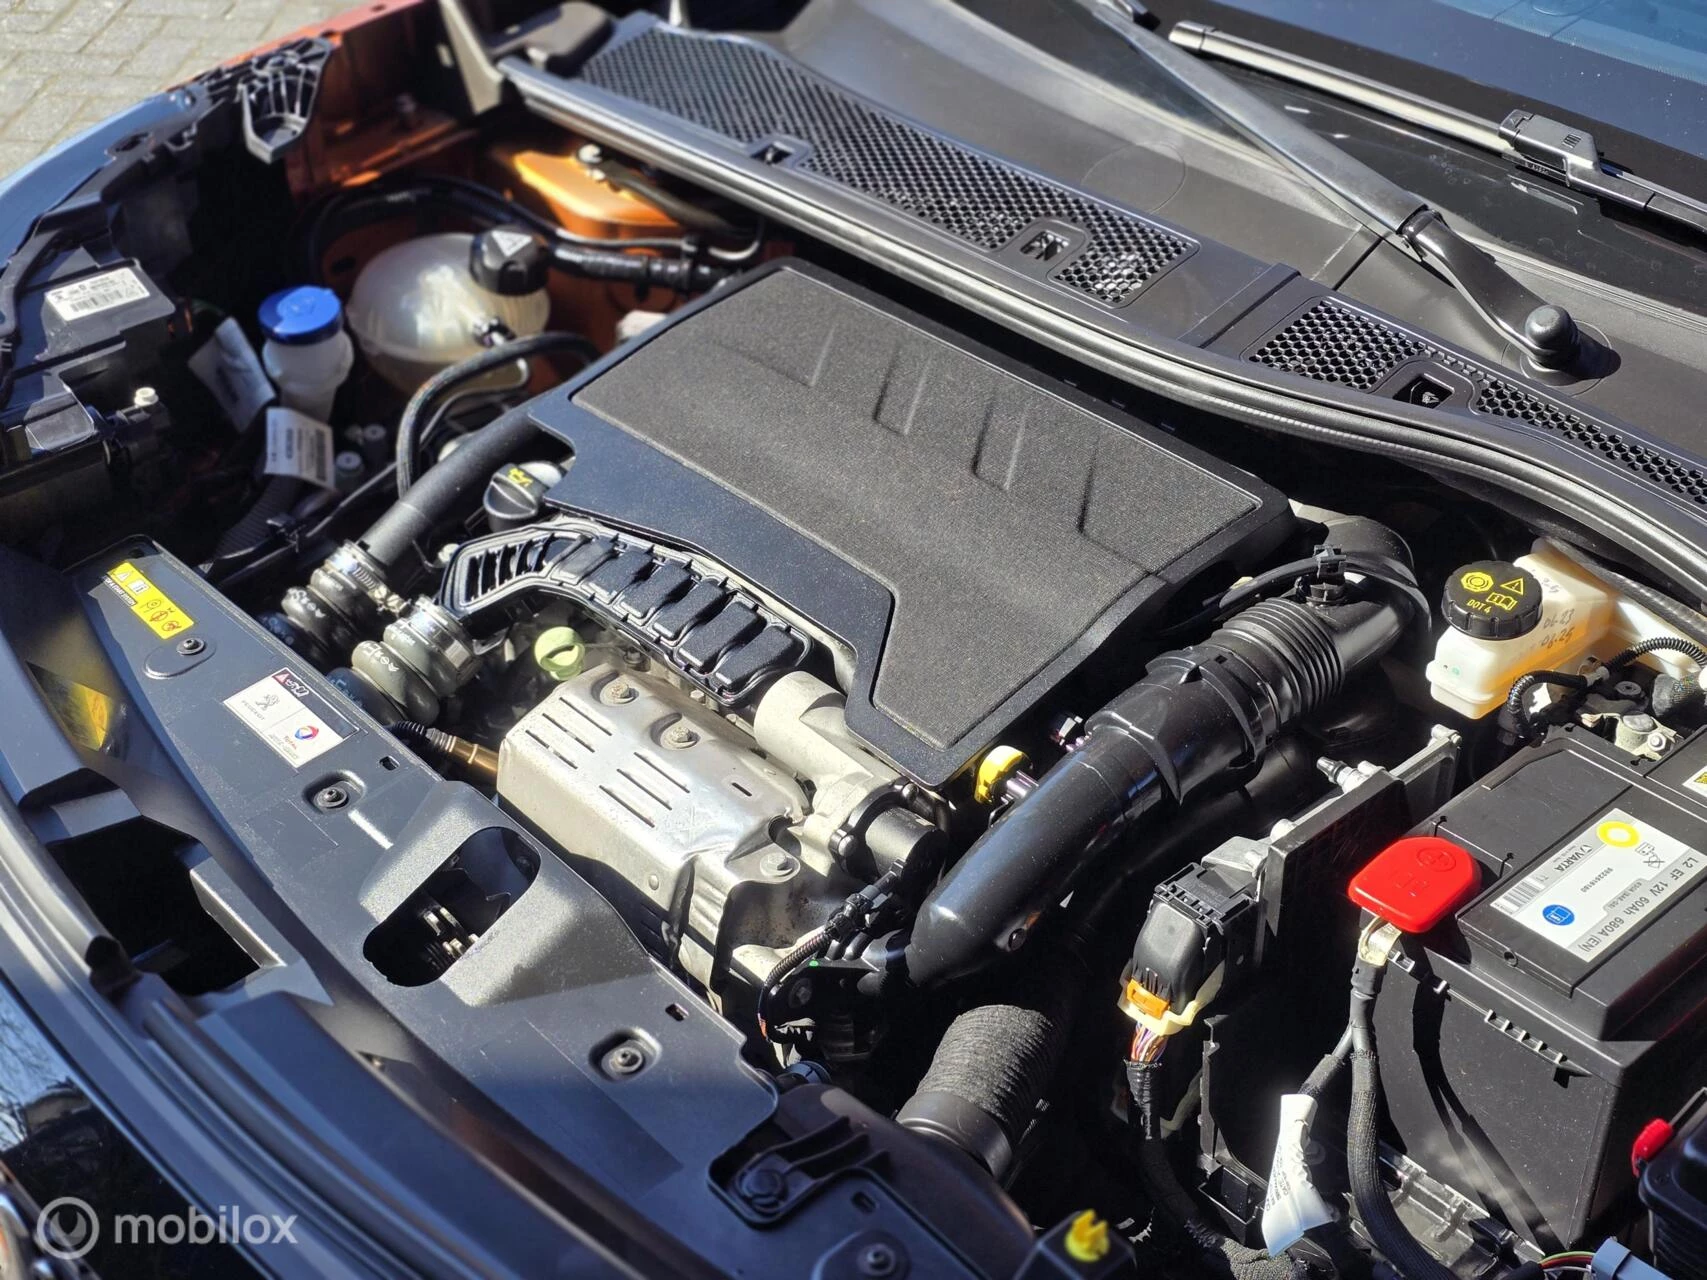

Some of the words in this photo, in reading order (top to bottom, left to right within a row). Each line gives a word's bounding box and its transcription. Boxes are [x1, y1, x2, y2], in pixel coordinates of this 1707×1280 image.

[1466, 599, 1486, 611] DOT
[1484, 605, 1492, 614] 4
[1553, 848, 1585, 873] VARTA
[1681, 856, 1699, 869] L2
[1670, 868, 1686, 881] EF
[1648, 880, 1669, 897] 12V
[1623, 892, 1651, 916] 60Ah
[1597, 915, 1626, 940] 680A
[1577, 936, 1603, 953] (EN)
